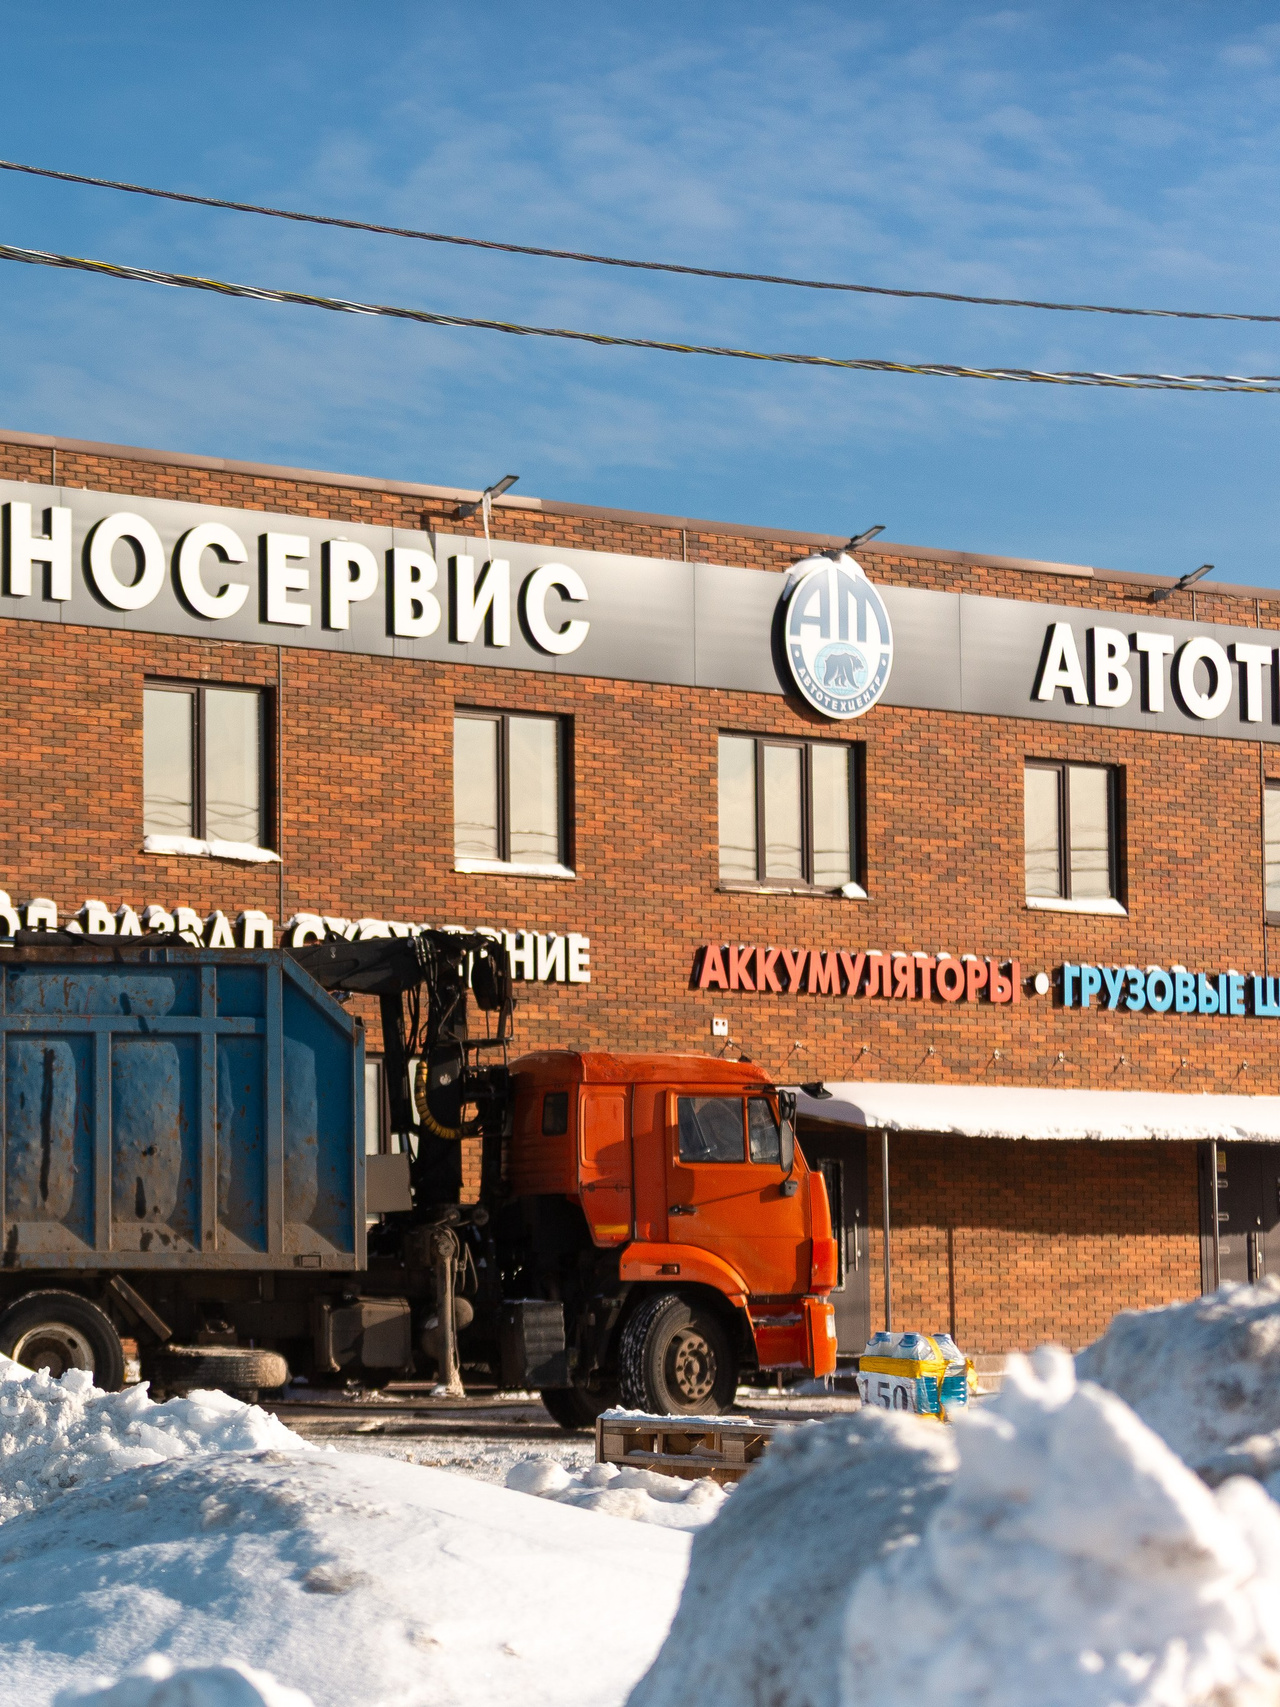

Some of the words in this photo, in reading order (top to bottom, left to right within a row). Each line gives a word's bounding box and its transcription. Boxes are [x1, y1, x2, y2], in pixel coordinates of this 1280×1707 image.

[797, 666, 882, 713] АВТОТЕХЦЕНТР
[1036, 622, 1280, 722] АВТОТ
[699, 944, 1020, 1003] АККУМУЛЯТОРЫ
[1063, 965, 1245, 1016] ГРУЗОВЫЕ
